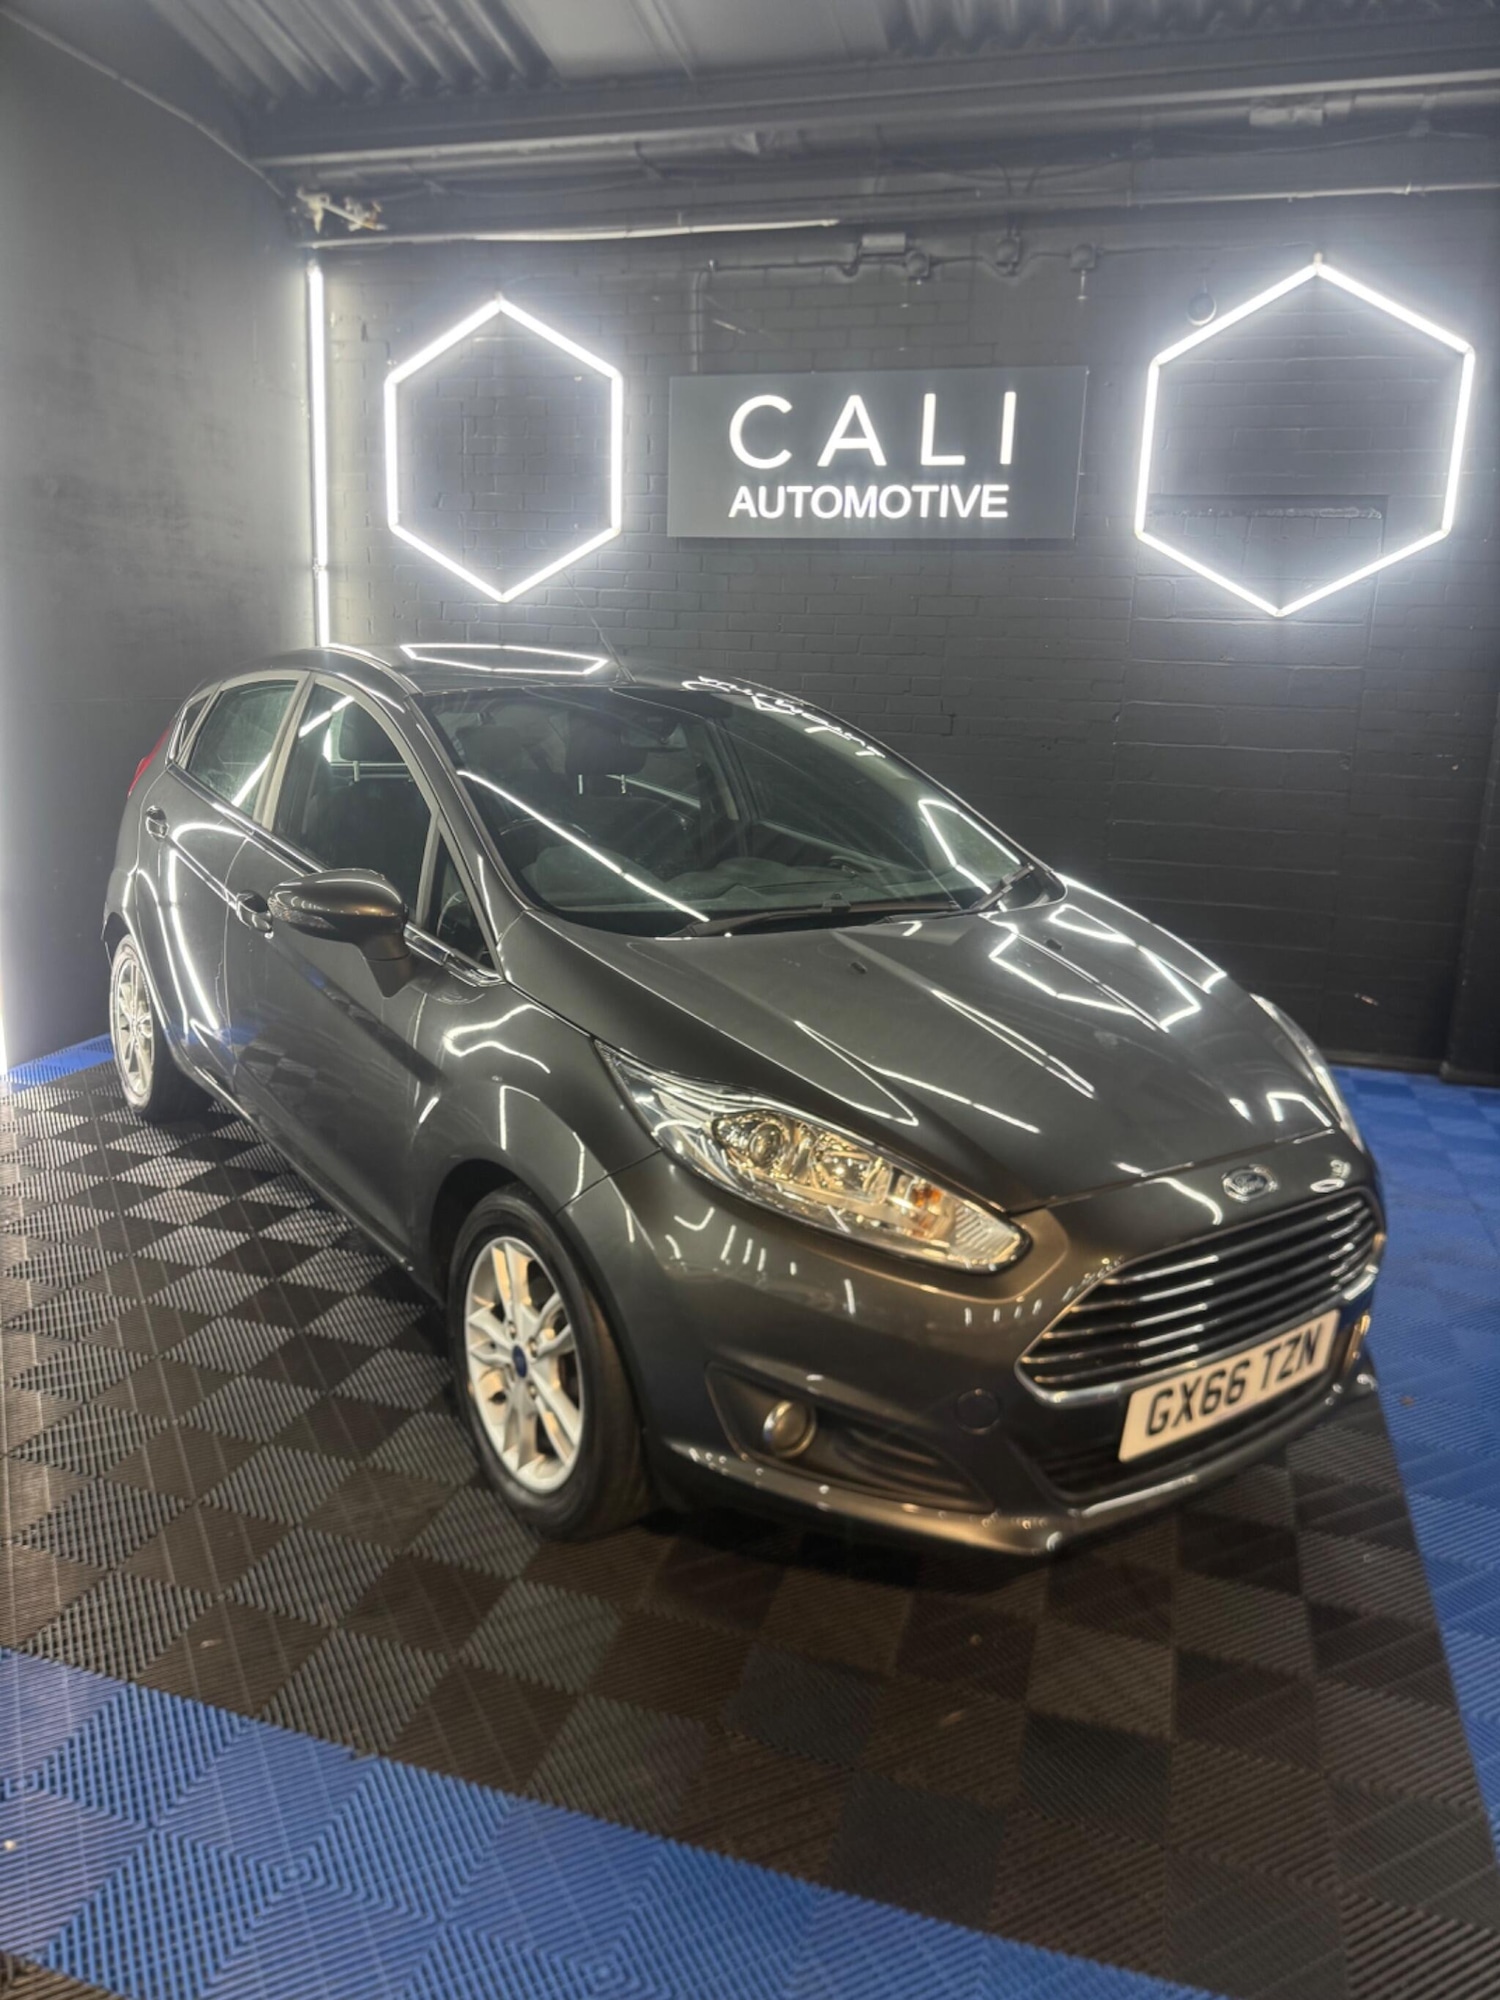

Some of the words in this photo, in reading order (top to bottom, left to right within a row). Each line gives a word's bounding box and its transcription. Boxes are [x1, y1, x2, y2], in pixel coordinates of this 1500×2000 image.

[728, 391, 1017, 470] CALI
[727, 483, 1010, 520] AUTOMOTIVE
[1145, 1360, 1250, 1436] GX66
[1260, 1322, 1322, 1392] TZN
